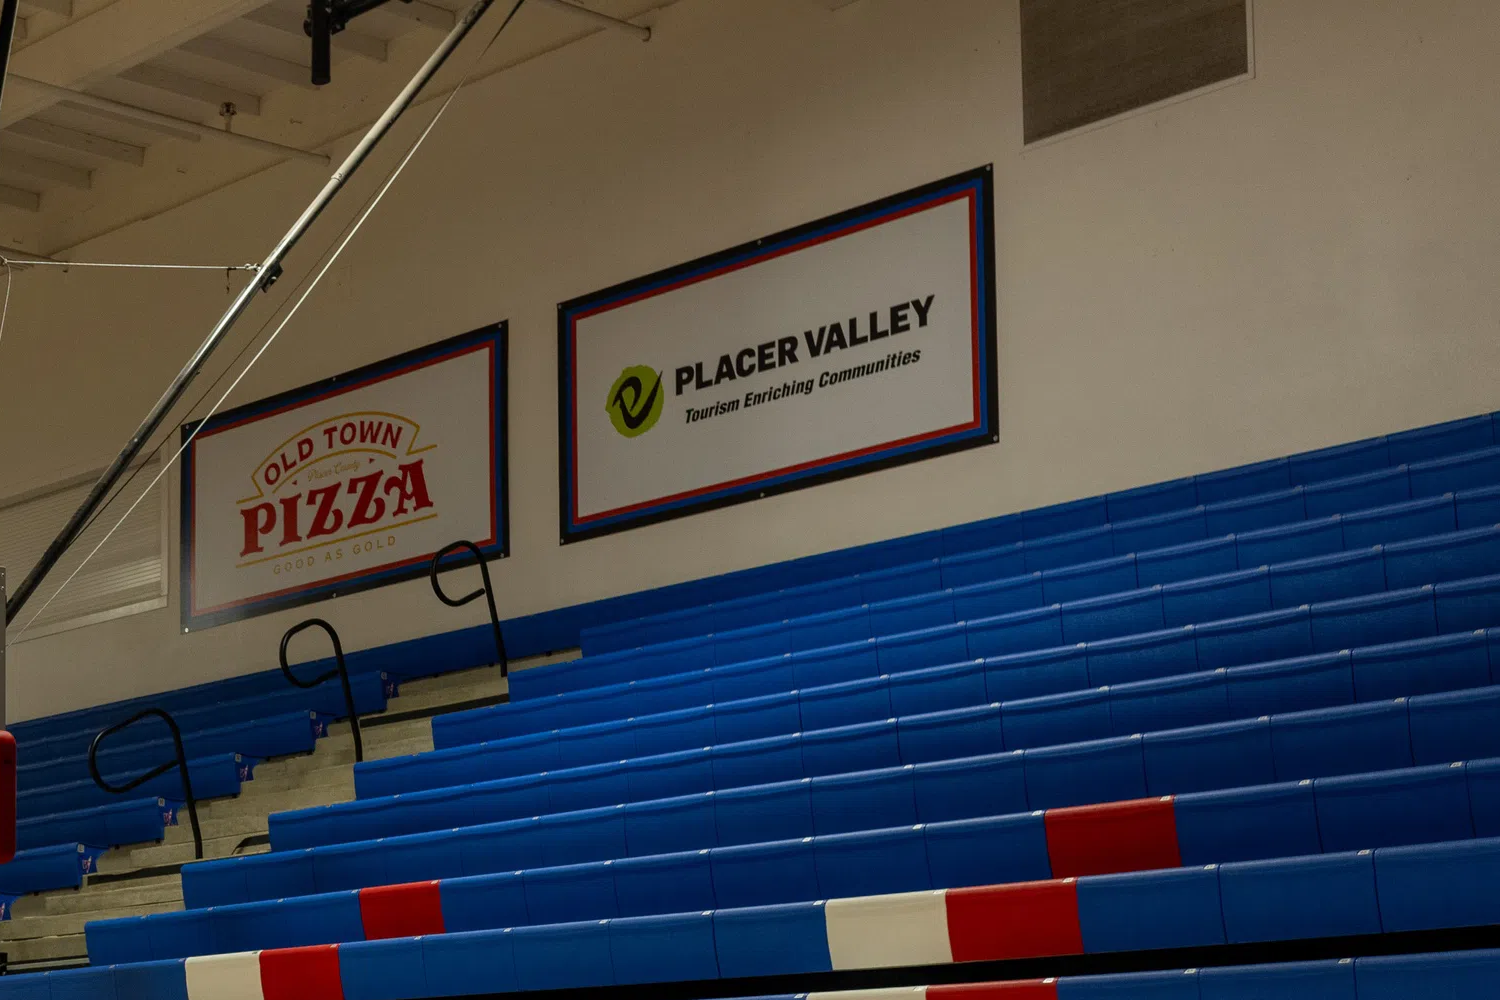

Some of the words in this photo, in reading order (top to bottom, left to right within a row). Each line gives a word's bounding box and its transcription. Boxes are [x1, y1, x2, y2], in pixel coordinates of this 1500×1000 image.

[674, 335, 799, 396] PLACER
[803, 295, 936, 358] VALLEY
[684, 399, 740, 425] Tourism
[743, 378, 815, 411] Enriching
[818, 347, 921, 389] Communities
[263, 437, 315, 486] OLD
[323, 420, 403, 450] TOWN
[239, 457, 434, 558] PIZZA
[272, 555, 315, 575] GOOD
[324, 548, 344, 562] AS
[352, 535, 396, 556] GOLD
